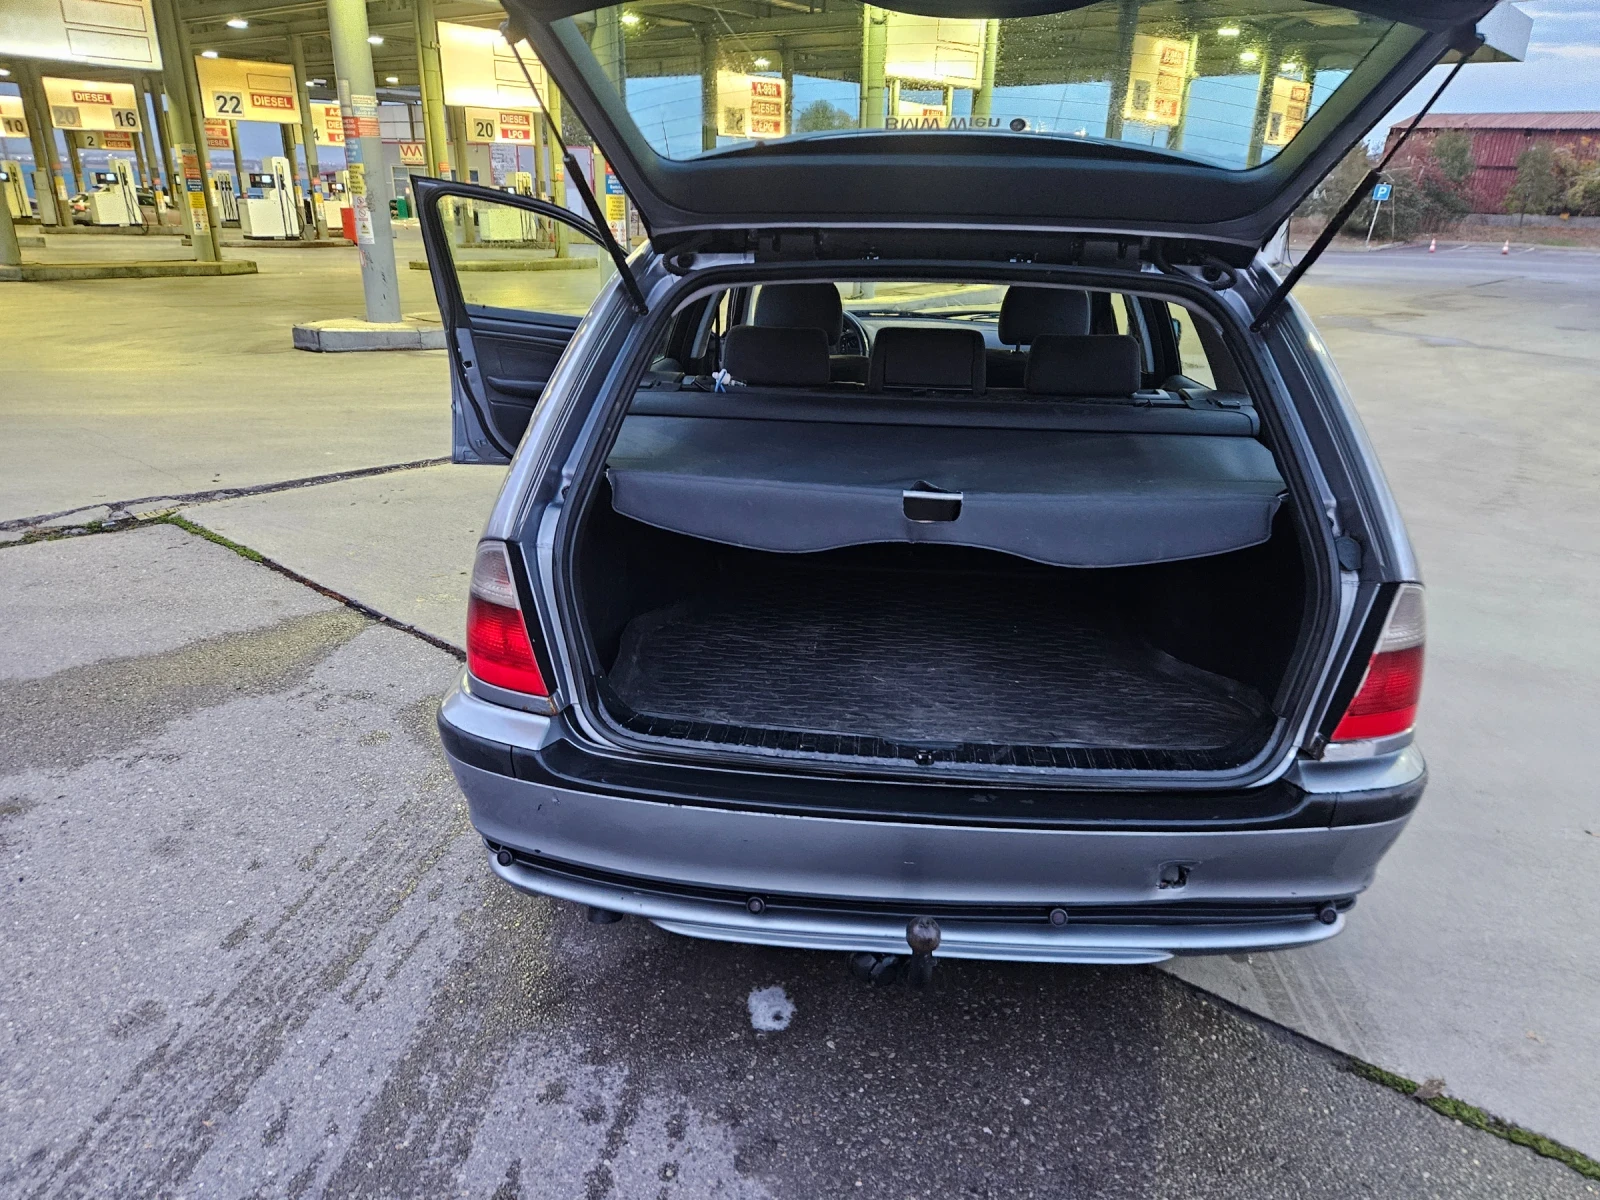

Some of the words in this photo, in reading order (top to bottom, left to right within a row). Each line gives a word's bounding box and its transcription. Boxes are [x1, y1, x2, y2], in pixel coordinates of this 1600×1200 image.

[75, 92, 110, 103] DIESEL
[253, 95, 291, 108] DIESEL
[216, 95, 242, 114] 22
[115, 111, 136, 127] 16
[501, 114, 529, 124] DIESEL
[5, 119, 23, 132] 10
[476, 122, 493, 138] 20
[508, 130, 523, 139] LPG
[86, 136, 95, 146] 2
[107, 140, 131, 148] DIESEL
[1377, 186, 1387, 198] P
